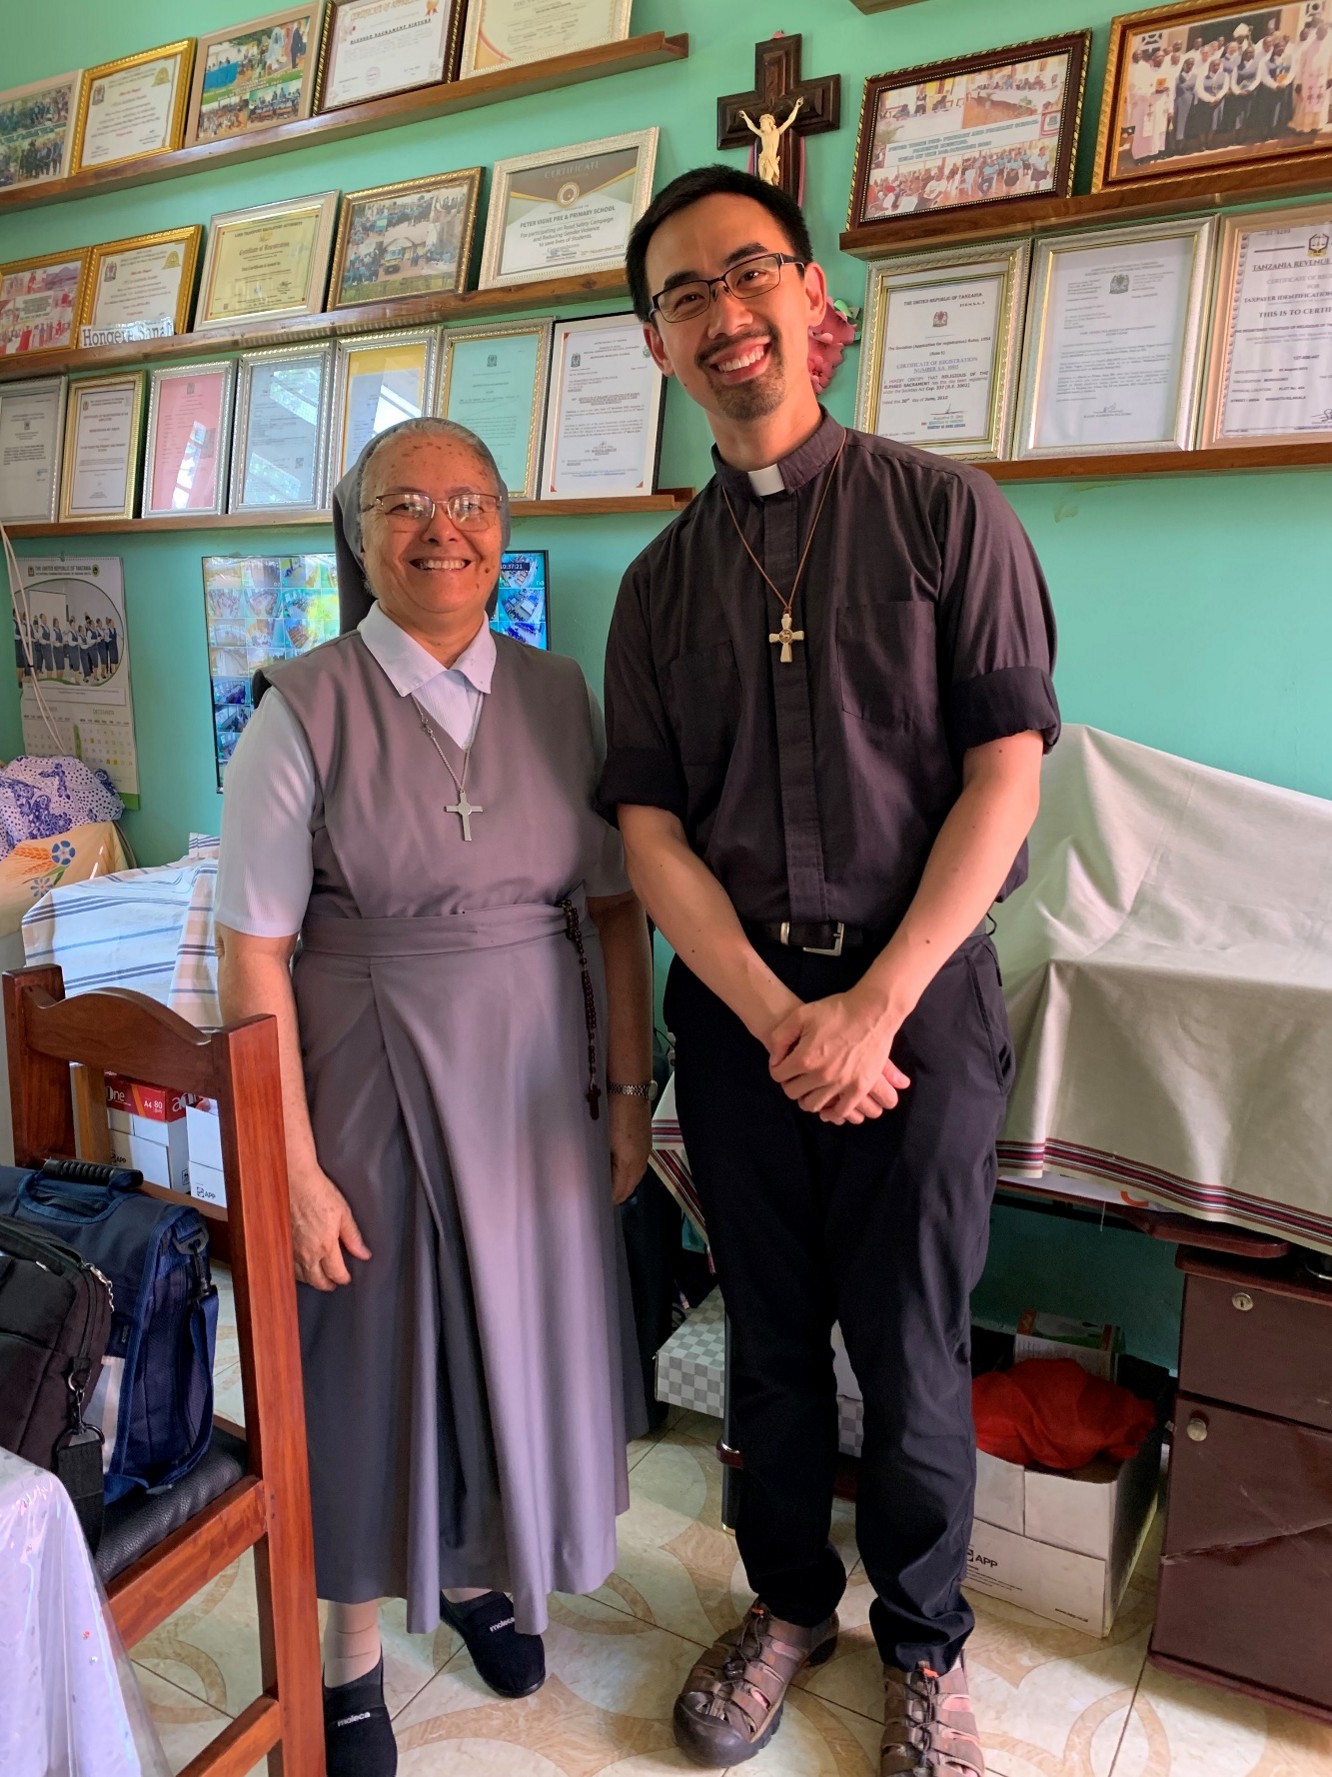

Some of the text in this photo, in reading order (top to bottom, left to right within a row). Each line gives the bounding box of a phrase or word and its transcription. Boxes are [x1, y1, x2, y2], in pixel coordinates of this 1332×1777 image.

[520, 219, 537, 229] PETER
[569, 209, 593, 219] PRIMARY
[593, 205, 616, 215] SCHOOL
[1252, 257, 1330, 272] TANZANIA REVENUE
[1244, 295, 1276, 303] TAXPAYER
[1259, 310, 1278, 318] THIS
[1290, 308, 1302, 316] TO
[144, 1100, 152, 1109] A4
[205, 1190, 216, 1199] APP
[975, 1554, 998, 1568] APP
[337, 1711, 371, 1727] moleca
